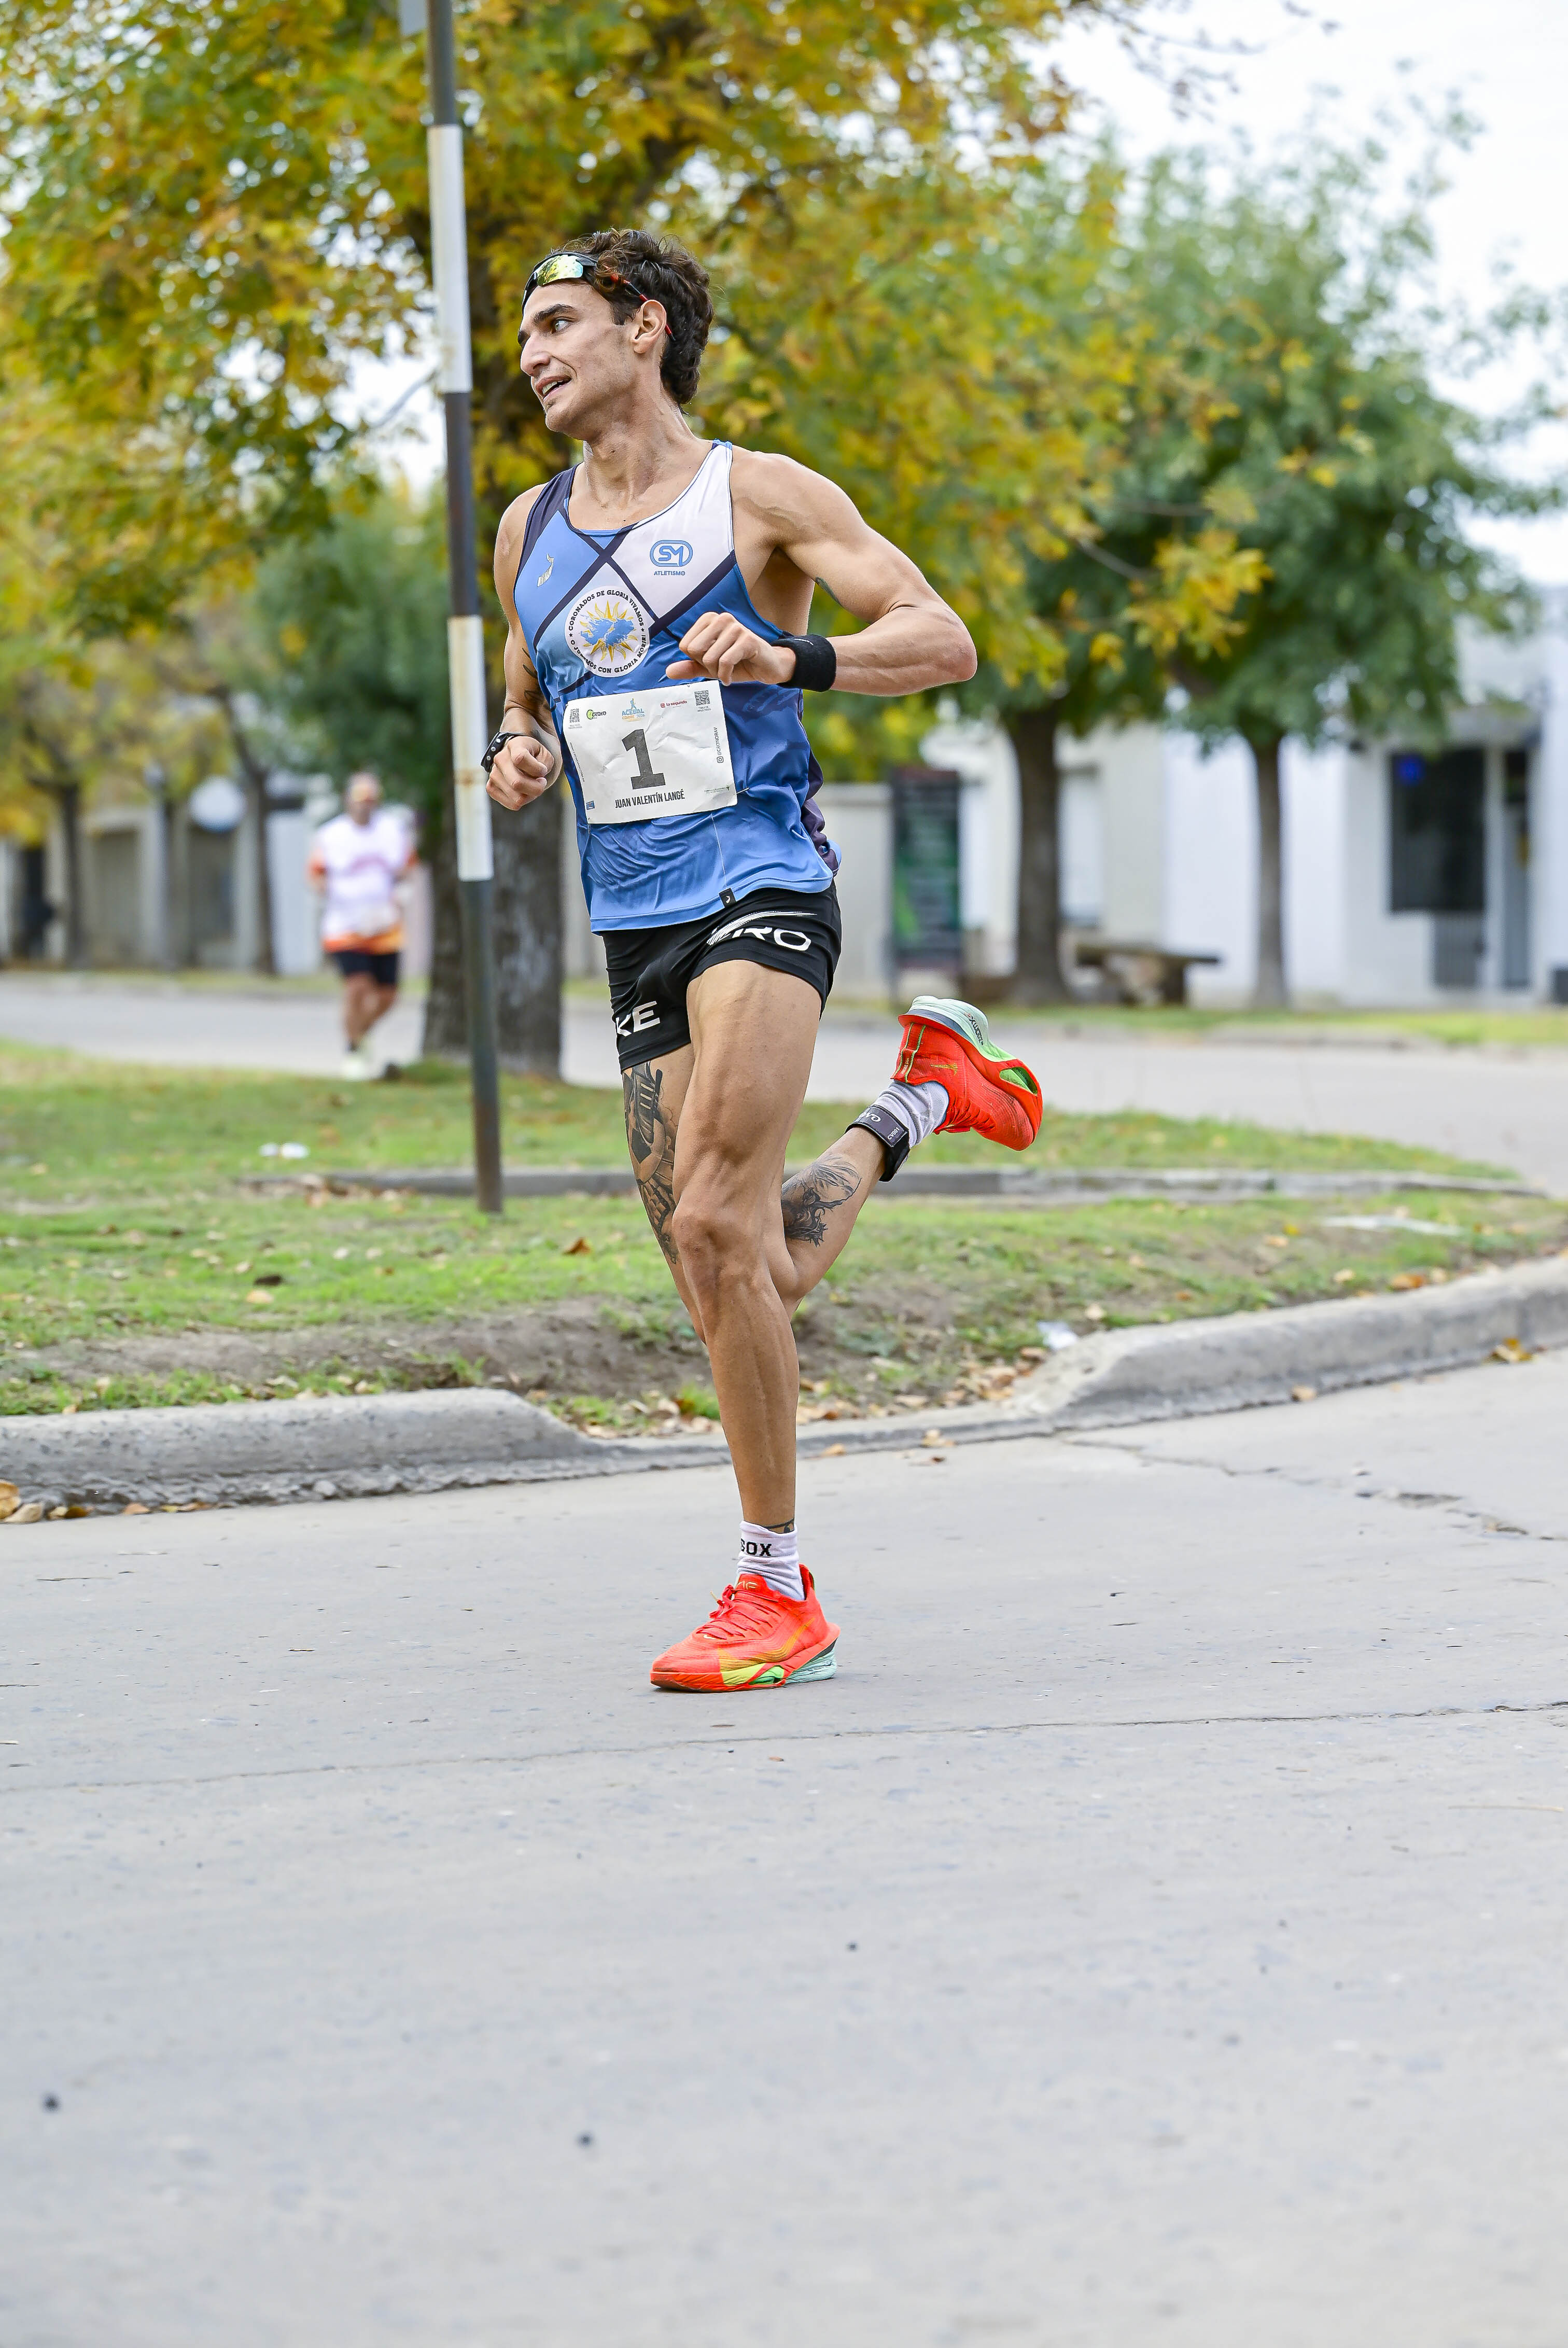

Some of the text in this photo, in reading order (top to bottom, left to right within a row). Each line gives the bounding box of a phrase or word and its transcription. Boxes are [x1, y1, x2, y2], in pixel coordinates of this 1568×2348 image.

[568, 594, 595, 631] CORONADOS
[607, 590, 629, 601] GLORIA
[629, 598, 644, 626] VIVAMOS
[614, 658, 638, 673] GLORIA
[621, 729, 666, 790] 1
[615, 788, 685, 808] JUAN VALENTÍN LANGÉ
[887, 1127, 900, 1140] CV001
